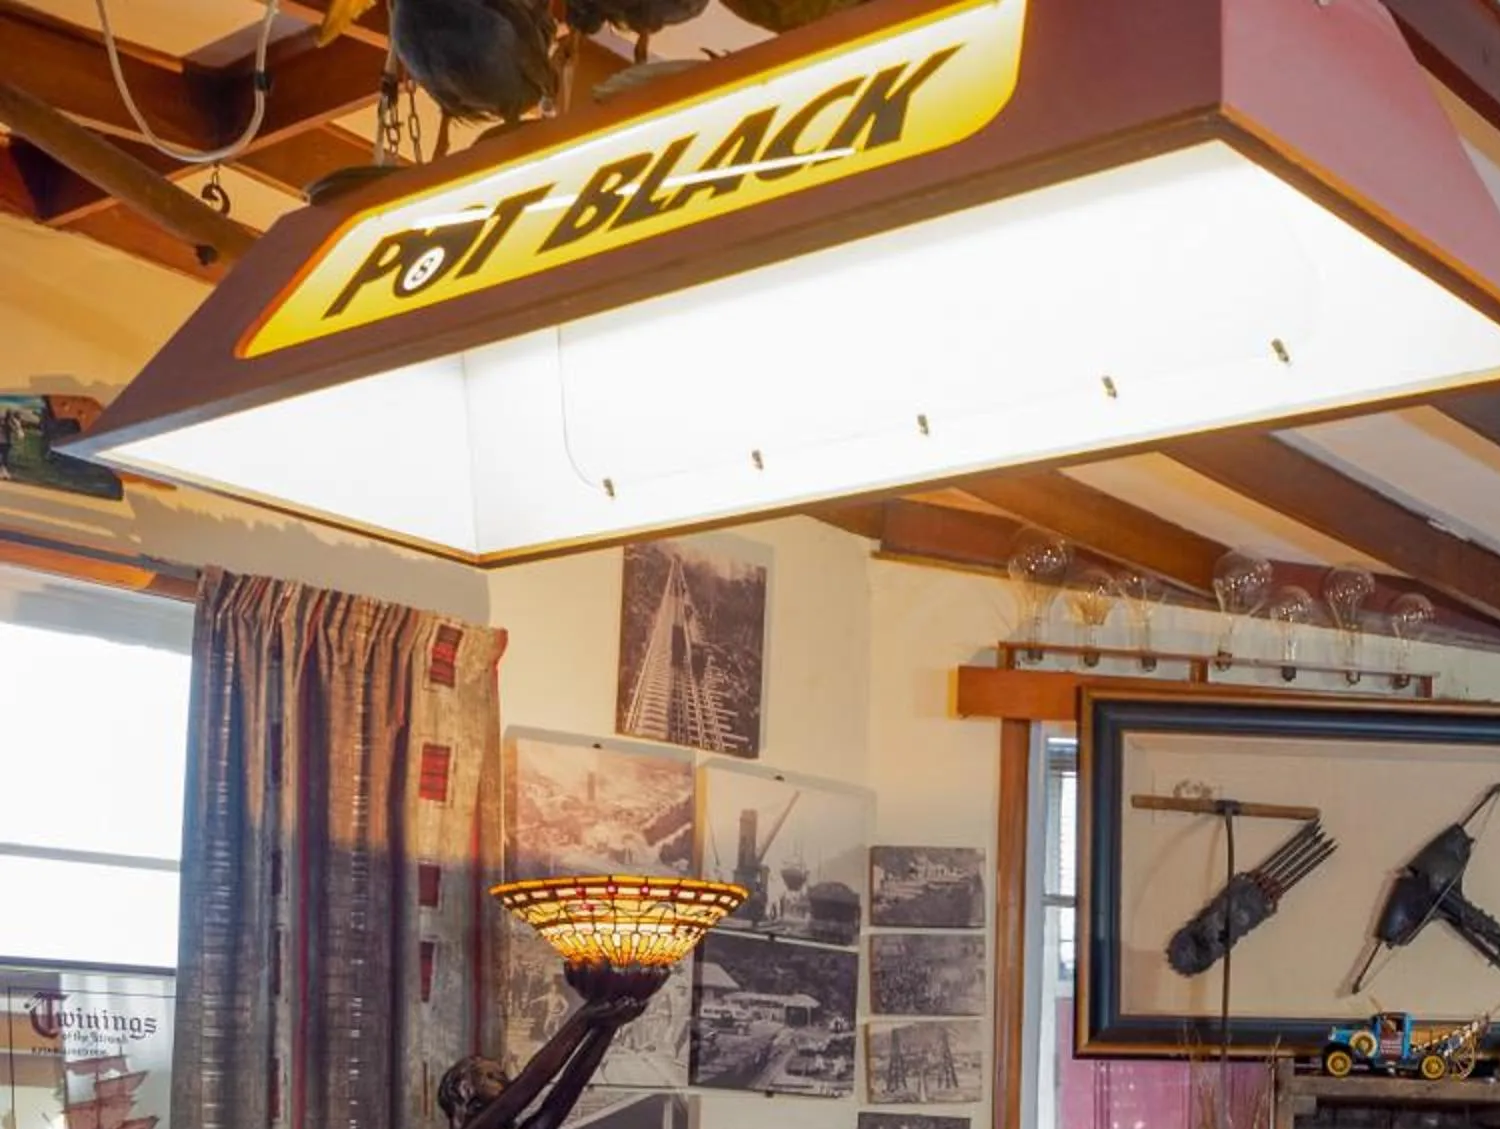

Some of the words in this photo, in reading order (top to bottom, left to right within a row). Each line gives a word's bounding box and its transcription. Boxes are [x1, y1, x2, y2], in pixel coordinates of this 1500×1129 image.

[322, 182, 556, 321] POT
[536, 42, 966, 255] BLACK
[24, 992, 158, 1040] Twinings
